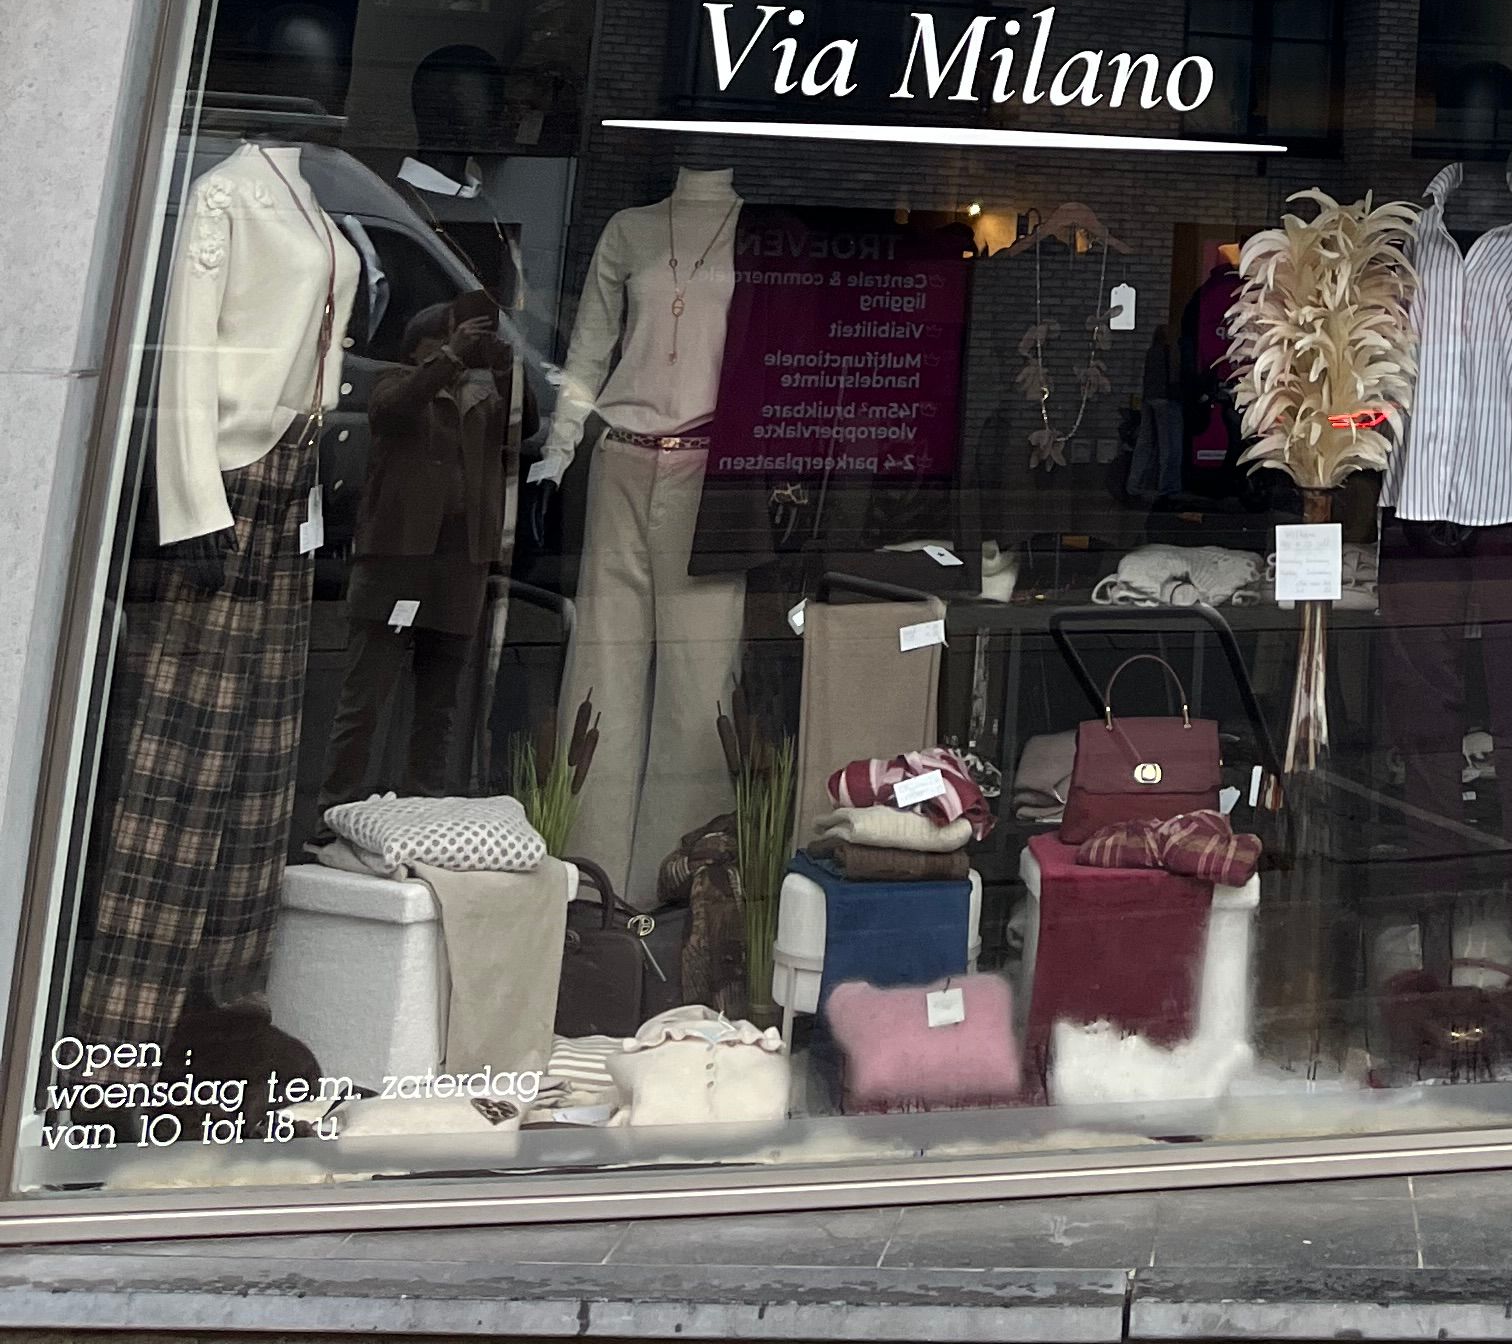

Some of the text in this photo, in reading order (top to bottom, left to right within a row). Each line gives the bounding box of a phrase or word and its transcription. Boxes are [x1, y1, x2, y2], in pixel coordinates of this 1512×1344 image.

[702, 2, 1214, 112] Via Milano
[51, 1035, 163, 1078] Open
[46, 1064, 544, 1111] woensdag t.e.m. zaterdag
[42, 1110, 341, 1151] van 10 tot 18 u
